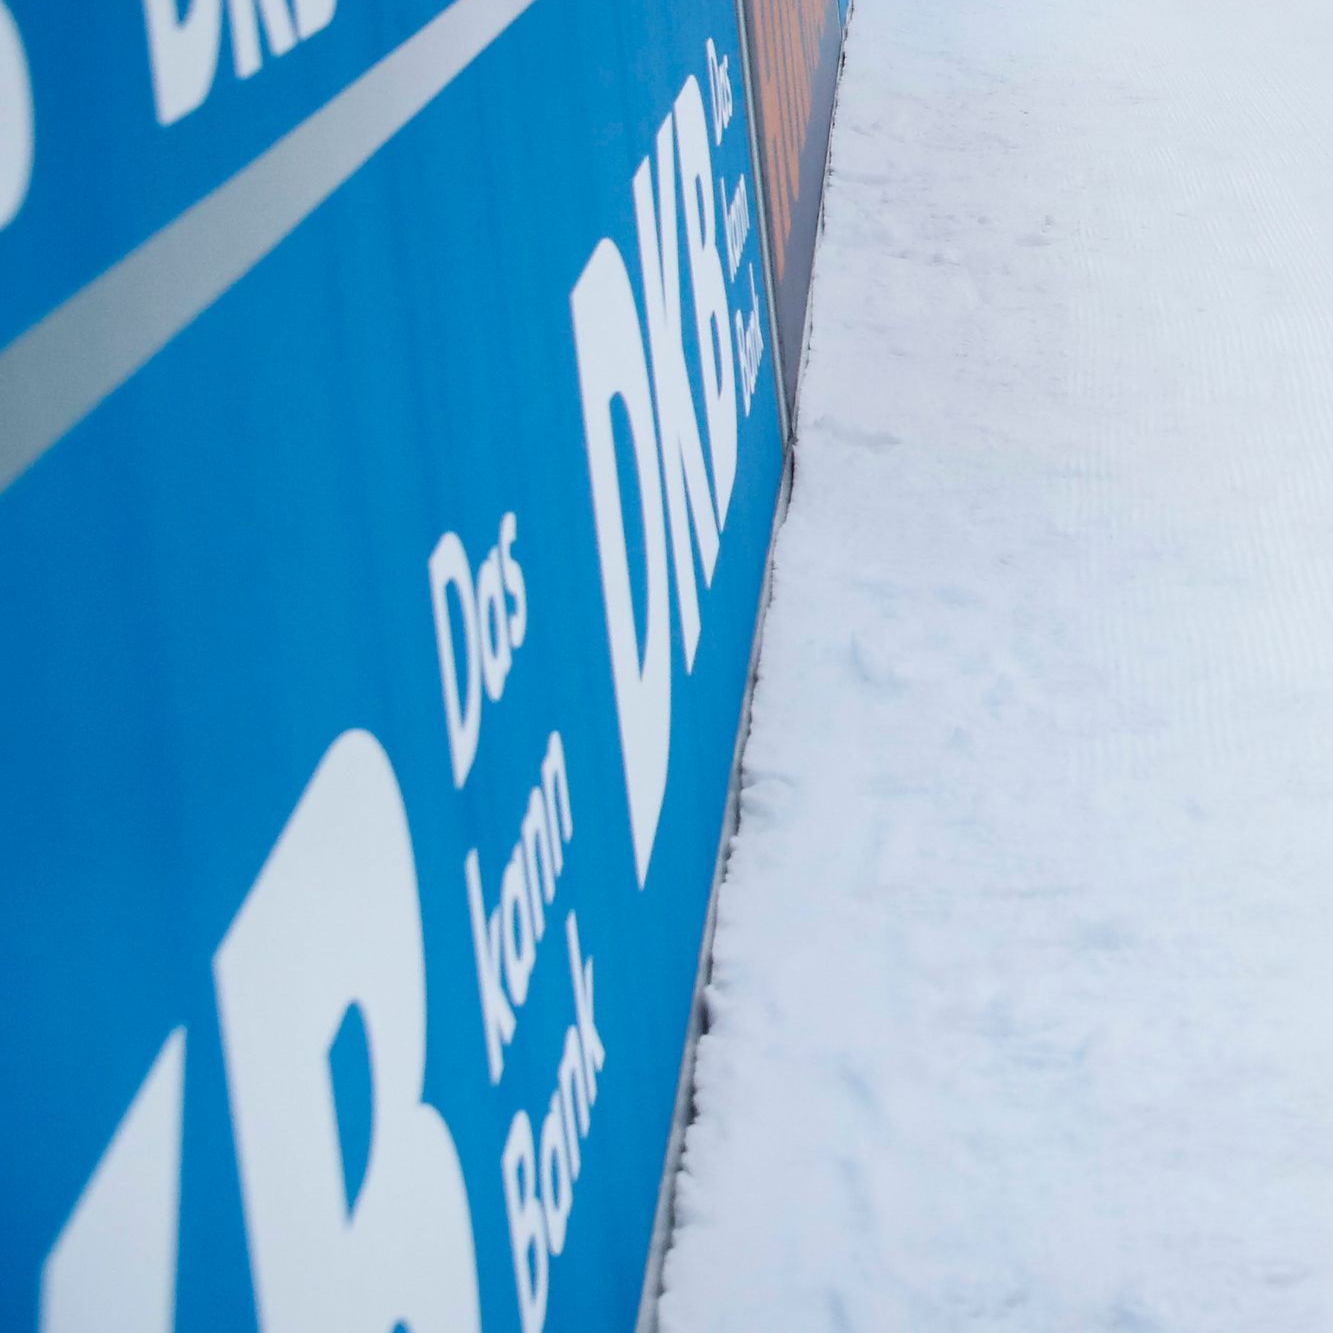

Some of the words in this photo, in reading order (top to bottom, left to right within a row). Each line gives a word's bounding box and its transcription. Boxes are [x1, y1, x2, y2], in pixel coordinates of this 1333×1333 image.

[428, 511, 527, 790] Das
[571, 73, 738, 891] DKB
[463, 730, 573, 1086] kann
[501, 909, 605, 1333] Bank
